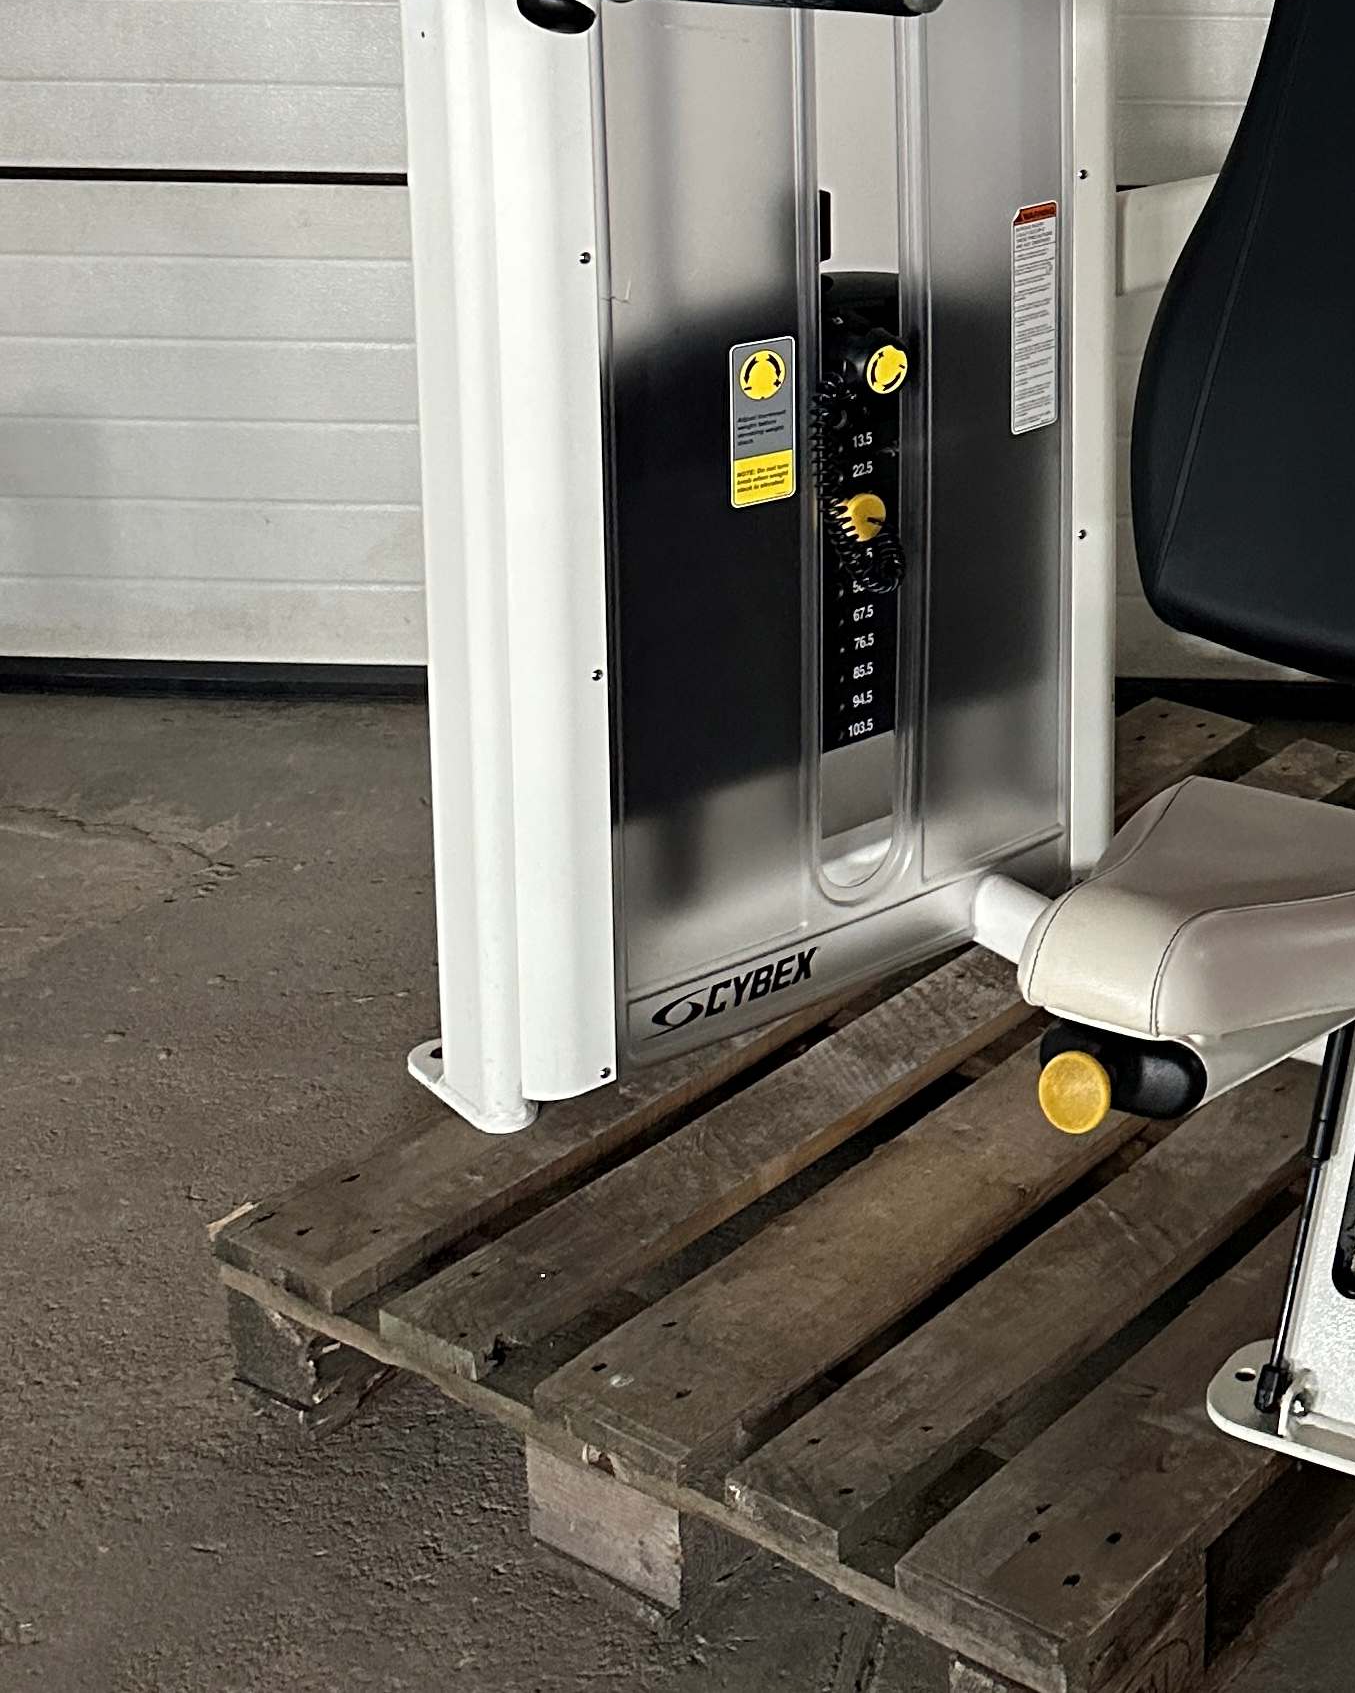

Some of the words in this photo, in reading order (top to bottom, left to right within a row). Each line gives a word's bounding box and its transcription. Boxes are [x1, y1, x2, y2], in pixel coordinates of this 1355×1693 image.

[852, 431, 873, 448] 13.5
[852, 460, 874, 478] 22.5
[853, 604, 874, 622] 67.5
[854, 633, 875, 650] 76.5
[853, 662, 874, 679] 85.5
[852, 690, 873, 708] 94.5
[848, 718, 874, 737] 103.5
[704, 946, 819, 1018] CYBEX
